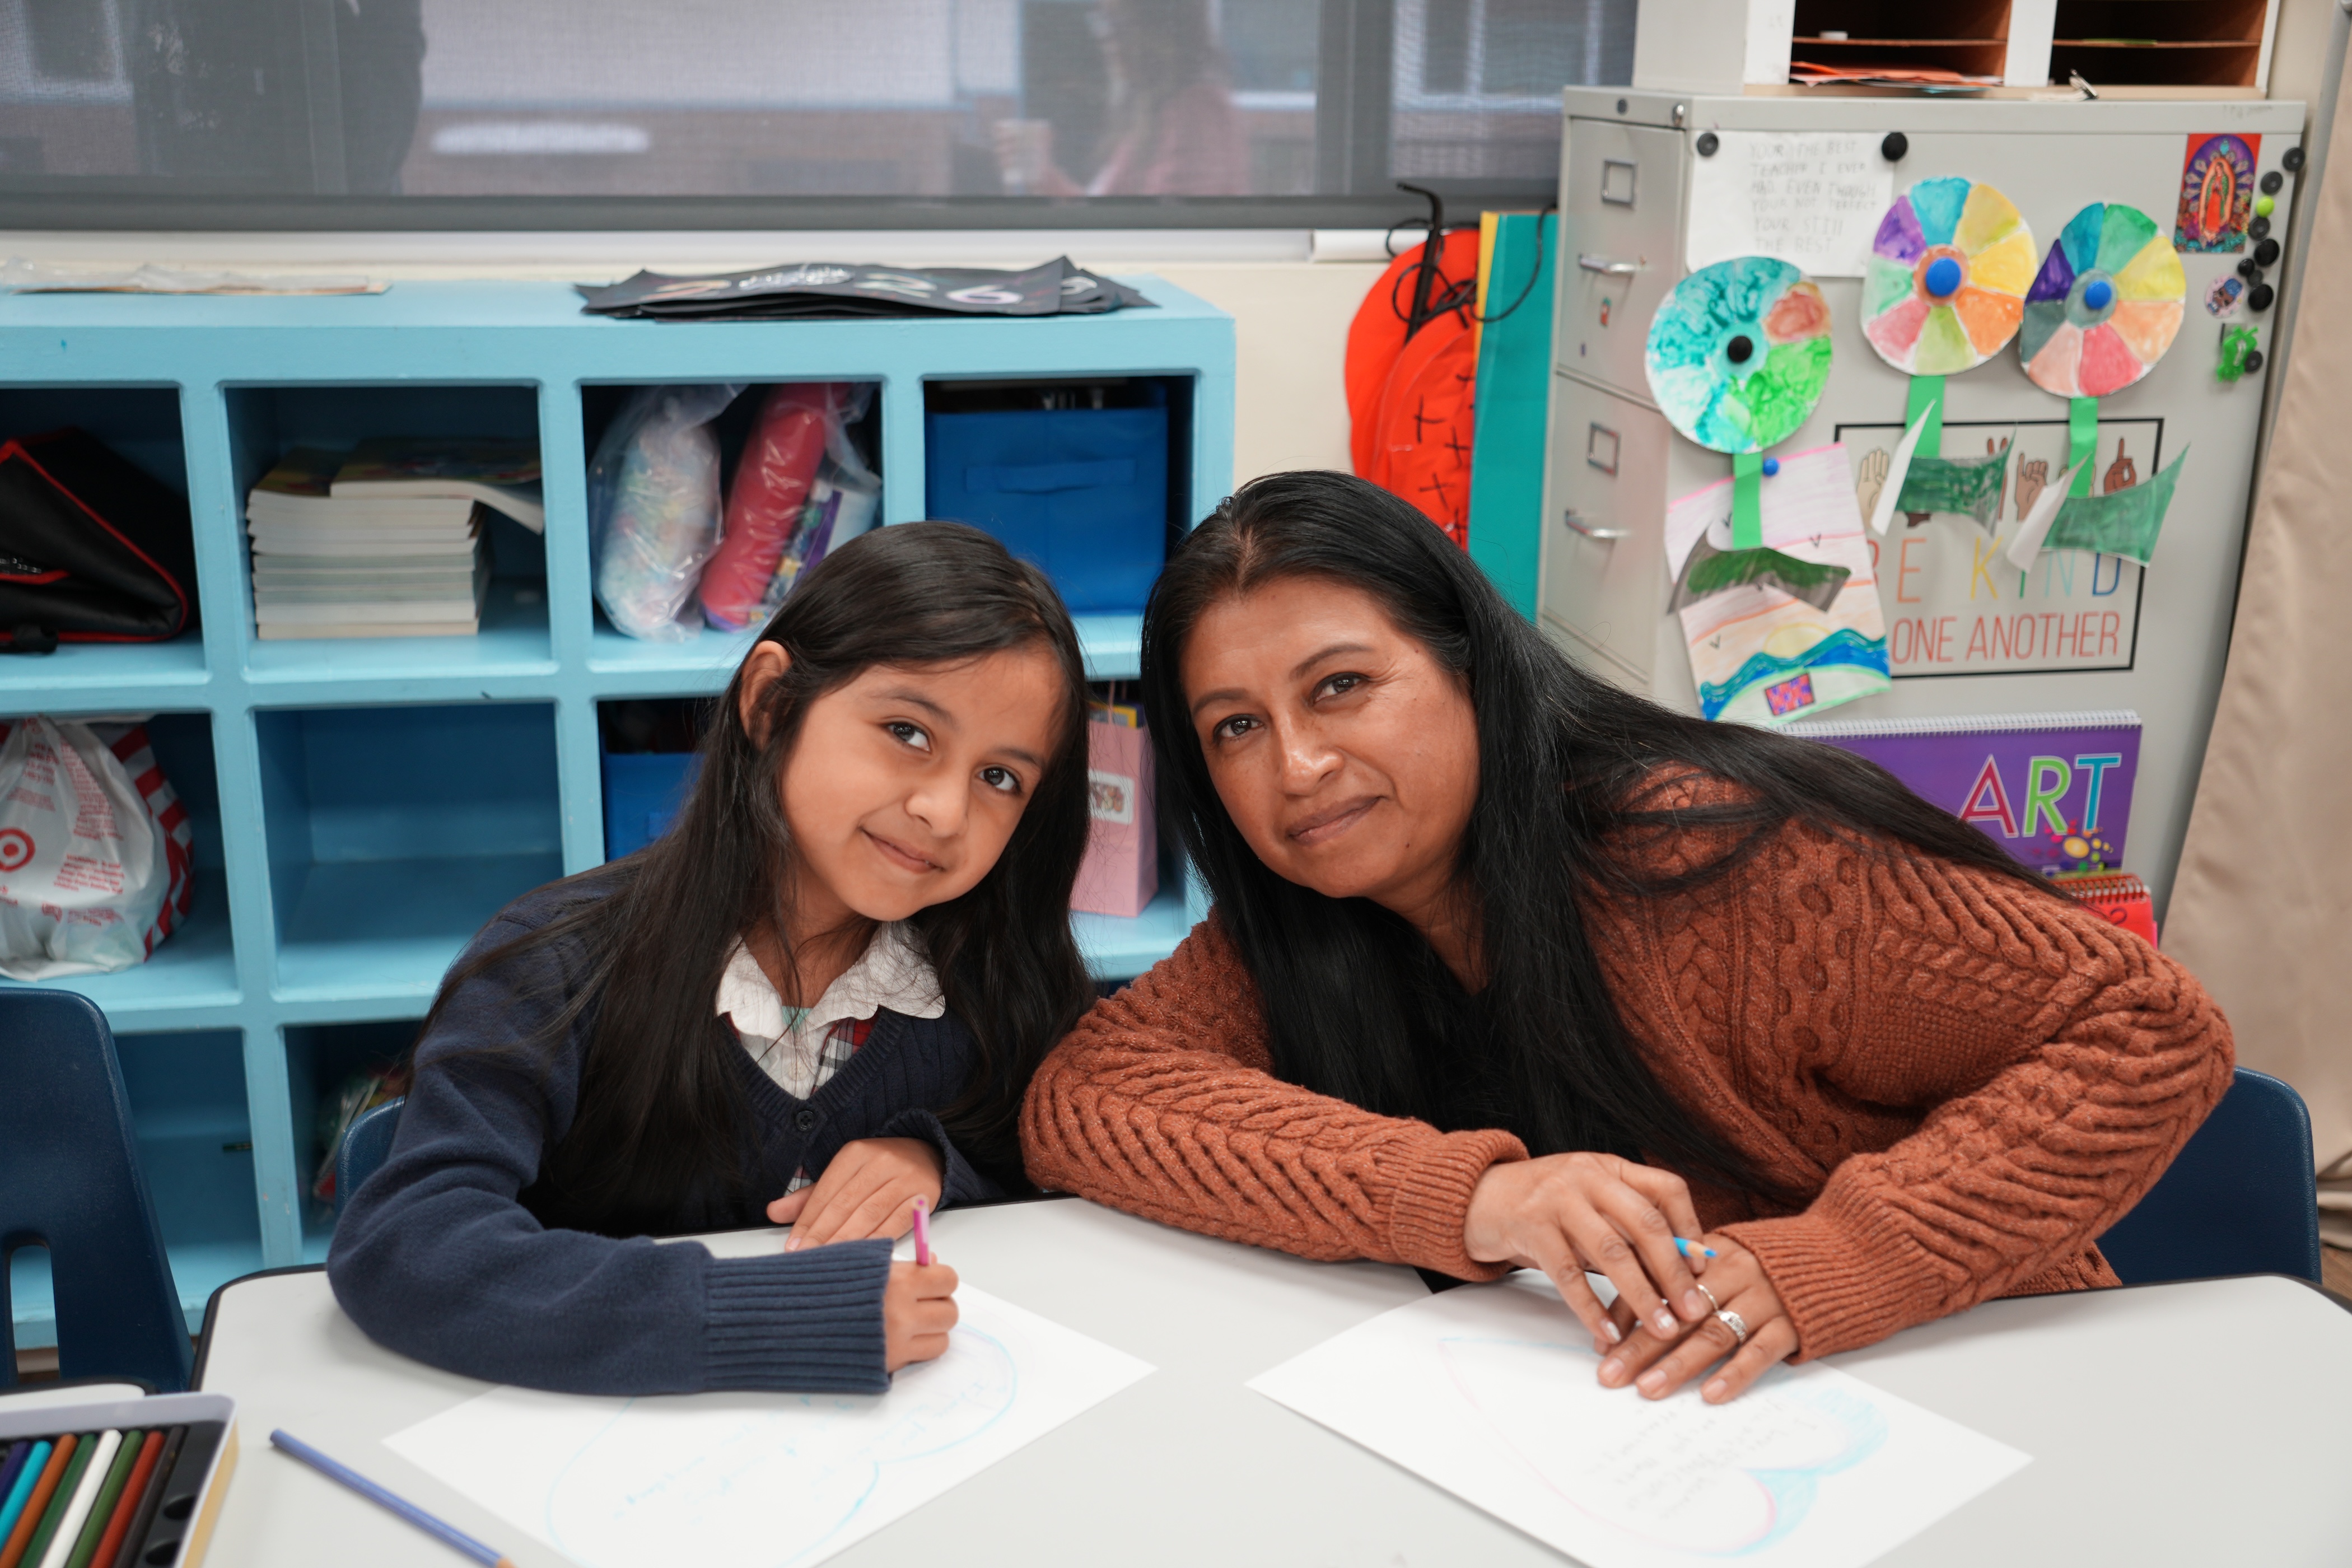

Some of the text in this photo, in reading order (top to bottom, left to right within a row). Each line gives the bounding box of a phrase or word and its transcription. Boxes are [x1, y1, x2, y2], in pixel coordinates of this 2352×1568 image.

[1796, 142, 1821, 157] THE
[1826, 140, 1858, 155] BEST
[1750, 161, 1866, 177] TEACHER I EVER
[1785, 178, 1823, 195] EVEN
[1828, 181, 1878, 198] THOUGH
[1751, 198, 1877, 213] YOUR NOT PERFECT
[1754, 217, 1790, 232] YOUR
[1754, 236, 1833, 253] THE BEST
[1892, 611, 2121, 665] ONE ANOTHER
[1958, 753, 2123, 838] ART
